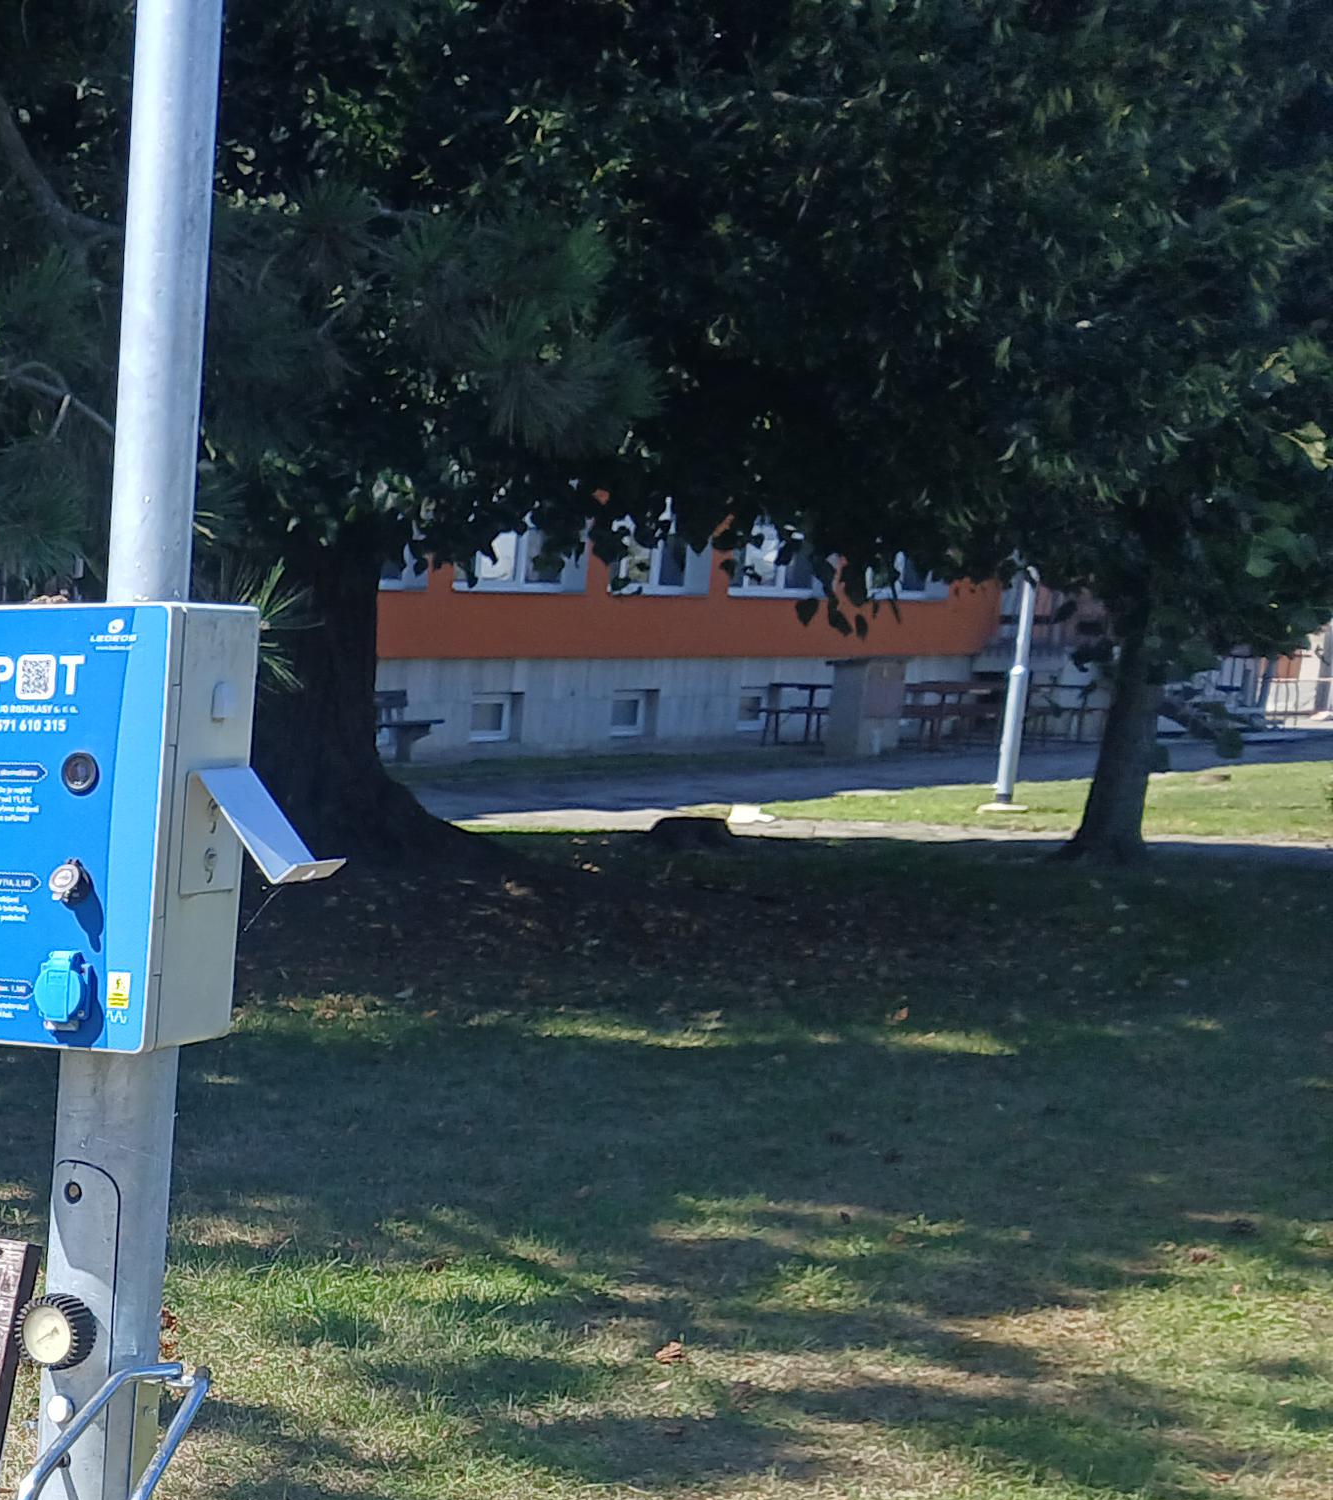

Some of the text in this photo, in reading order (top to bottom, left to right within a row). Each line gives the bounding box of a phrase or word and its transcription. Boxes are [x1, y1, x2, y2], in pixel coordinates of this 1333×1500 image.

[9, 704, 53, 714] ROZHLASY
[19, 719, 42, 732] 610
[43, 719, 67, 732] 315
